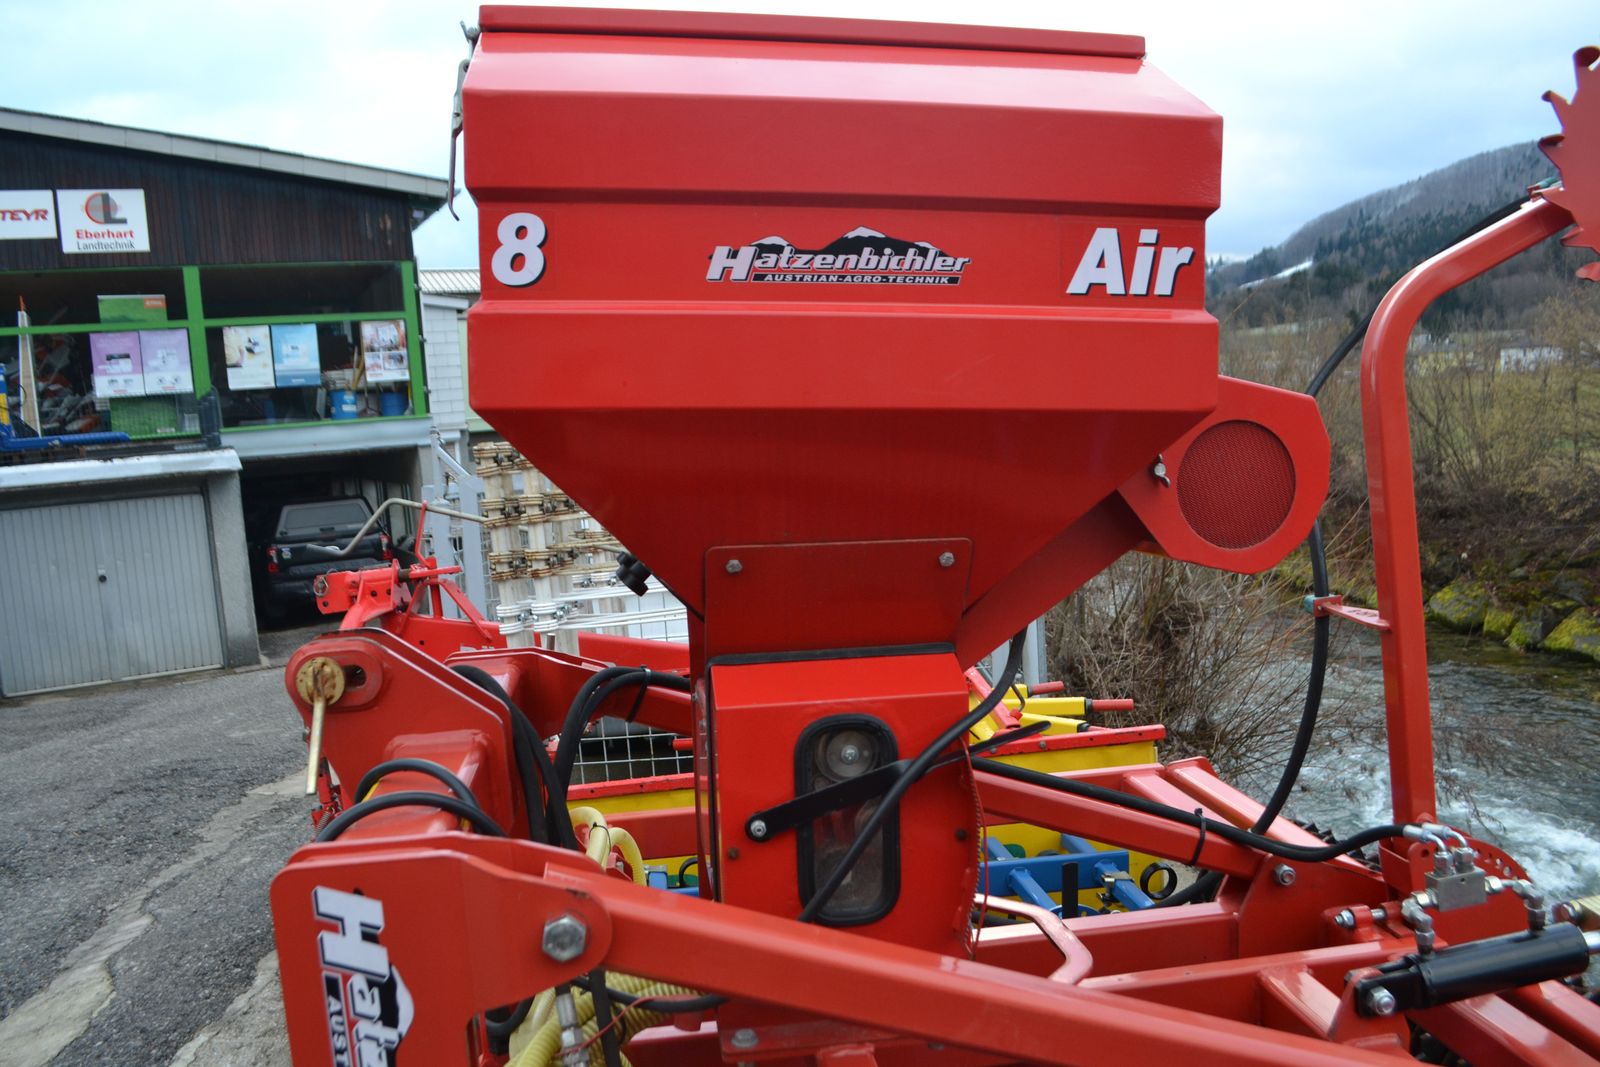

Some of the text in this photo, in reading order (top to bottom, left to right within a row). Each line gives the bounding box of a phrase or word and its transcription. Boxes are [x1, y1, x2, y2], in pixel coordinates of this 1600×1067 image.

[75, 229, 134, 239] Eberhart
[76, 241, 135, 250] Landtechnik
[491, 212, 548, 288] 8
[1065, 227, 1195, 297] Air
[706, 245, 972, 282] Hatzenbichler
[764, 273, 949, 284] AUSTRIAN-AGRO-TECHNIK
